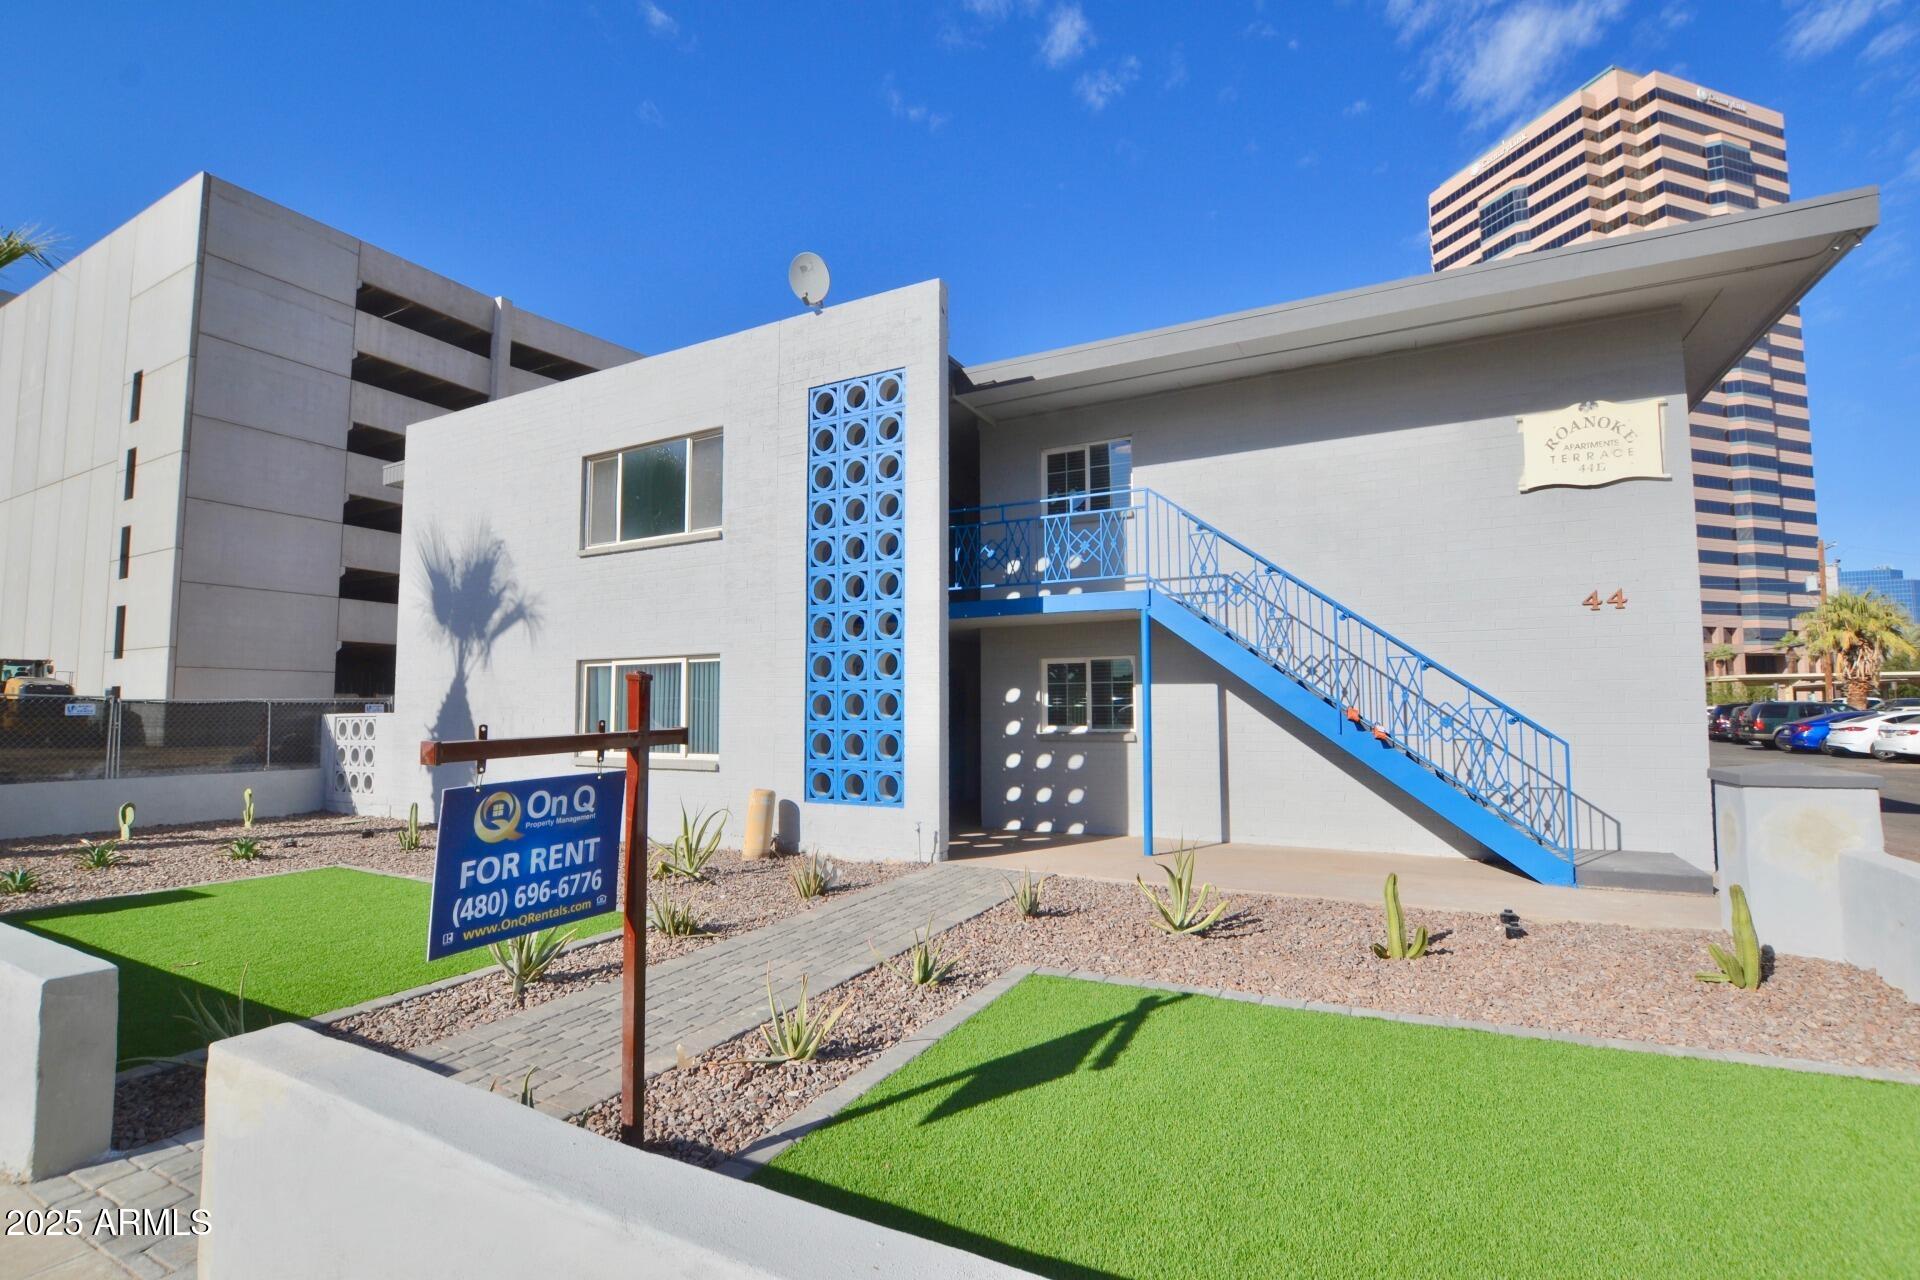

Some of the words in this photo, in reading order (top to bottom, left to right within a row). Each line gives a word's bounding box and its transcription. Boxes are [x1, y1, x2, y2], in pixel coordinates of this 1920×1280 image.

[1545, 416, 1638, 451] ROANOKE
[1563, 439, 1620, 451] APARTMENTS
[1550, 447, 1634, 464] TERRACE
[1582, 588, 1628, 611] 44
[527, 790, 568, 819] On
[573, 785, 597, 813] Q
[525, 819, 555, 830] Property
[556, 813, 596, 825] Management
[459, 852, 520, 890] FOR
[530, 837, 601, 875] RENT
[452, 888, 508, 929] (480)
[515, 868, 602, 909] 696-6776
[463, 900, 592, 941] www.OnQRentals.com
